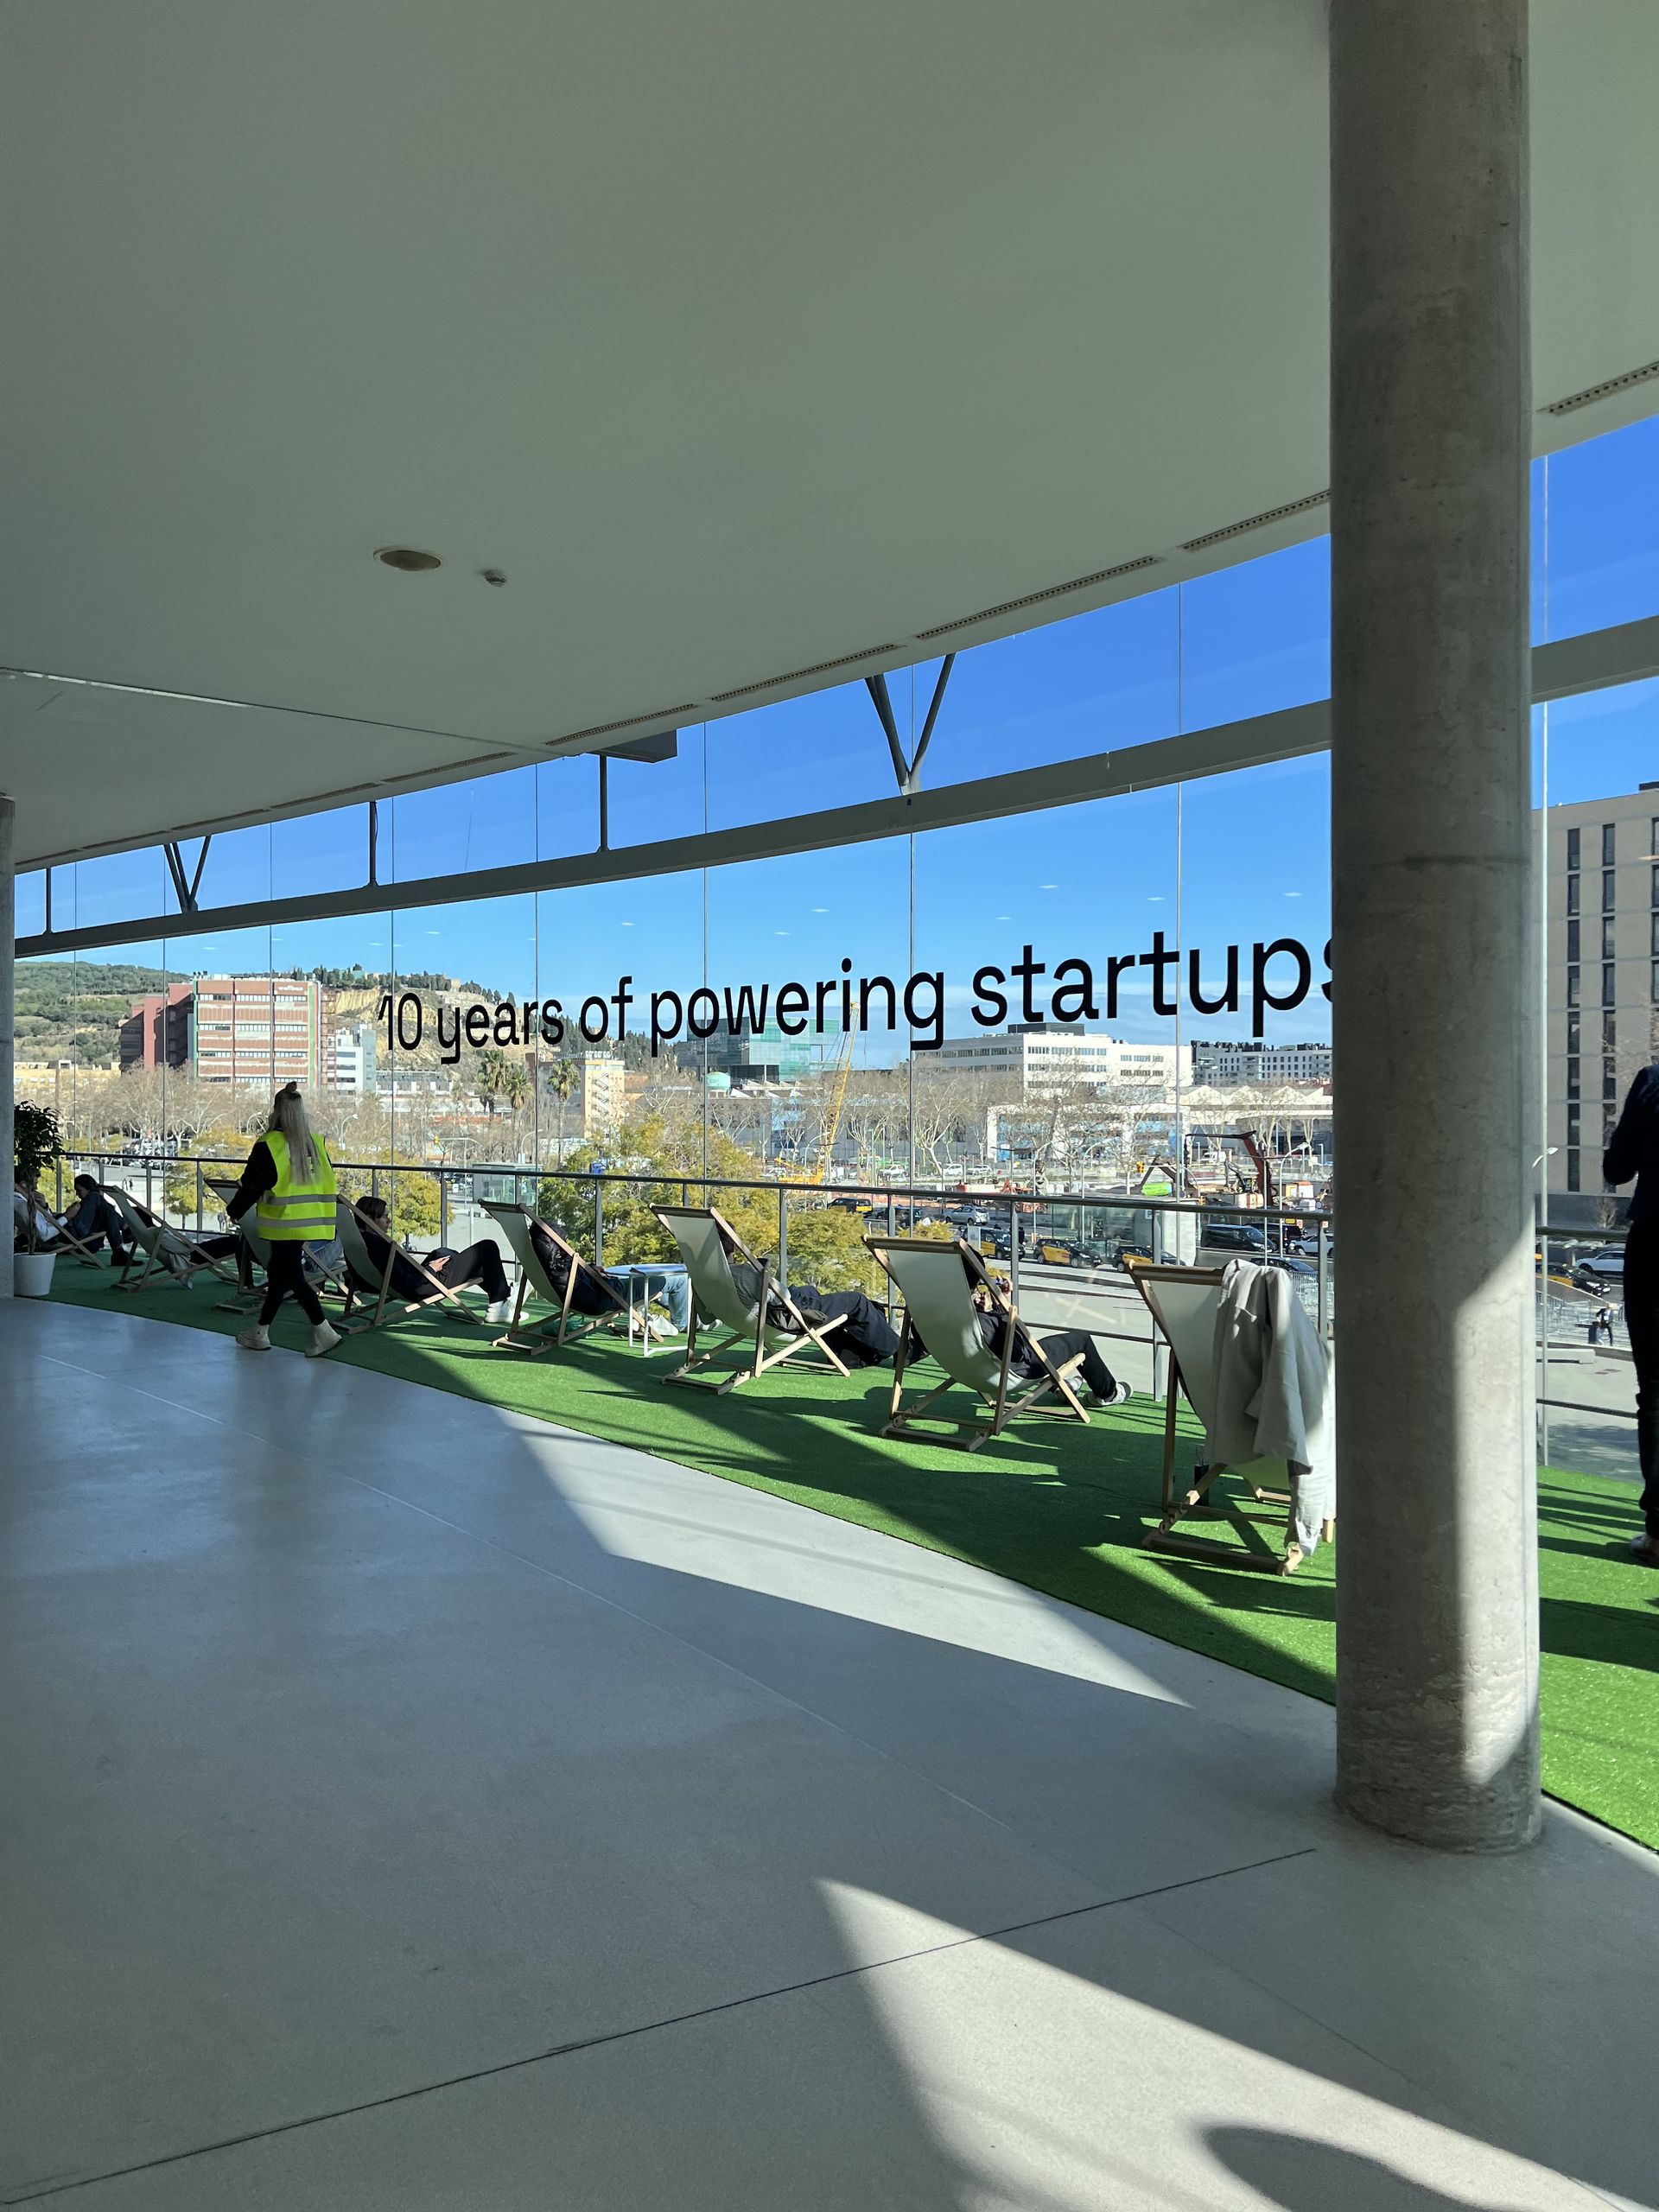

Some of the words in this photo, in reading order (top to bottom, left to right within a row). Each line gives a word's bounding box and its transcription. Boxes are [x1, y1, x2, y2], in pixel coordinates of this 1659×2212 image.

[378, 992, 423, 1051] 10
[437, 1000, 564, 1065] years
[580, 976, 633, 1044] of
[651, 957, 944, 1058] powering
